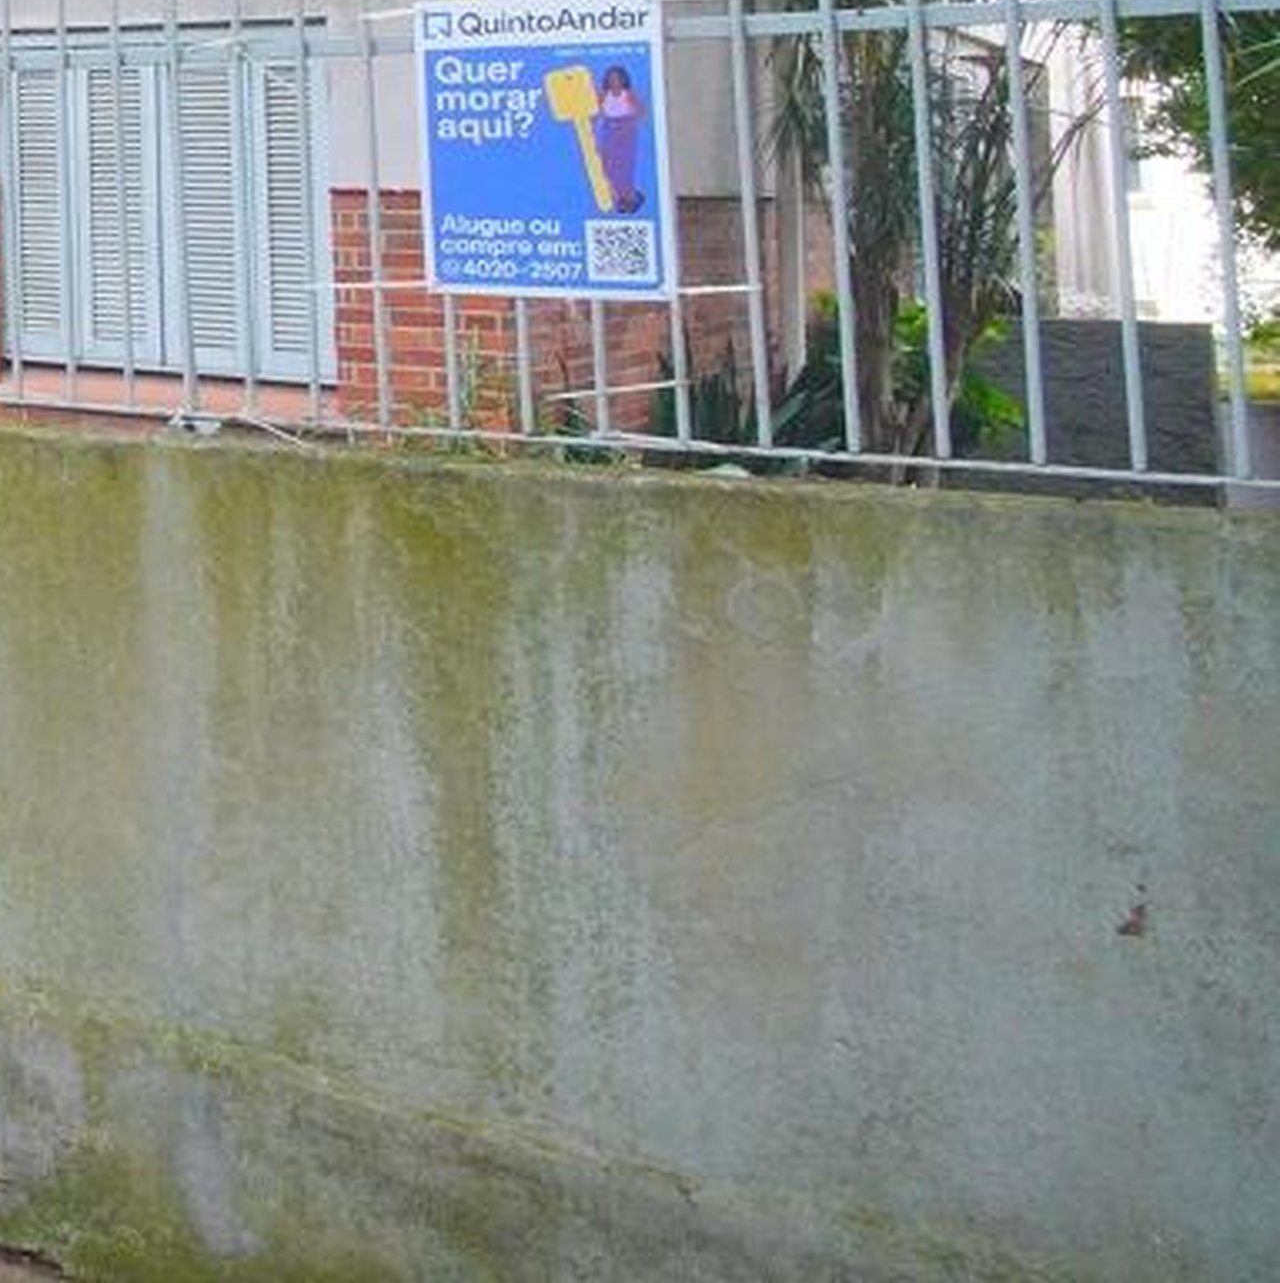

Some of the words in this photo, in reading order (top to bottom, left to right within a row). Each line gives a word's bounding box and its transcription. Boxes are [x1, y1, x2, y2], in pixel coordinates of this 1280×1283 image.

[457, 7, 650, 36] QuintoAndar
[434, 57, 524, 85] Quer
[437, 86, 541, 112] morar
[437, 112, 534, 145] aqui?
[440, 213, 525, 237] Alugue
[529, 219, 561, 235] ou
[440, 239, 533, 257] compre
